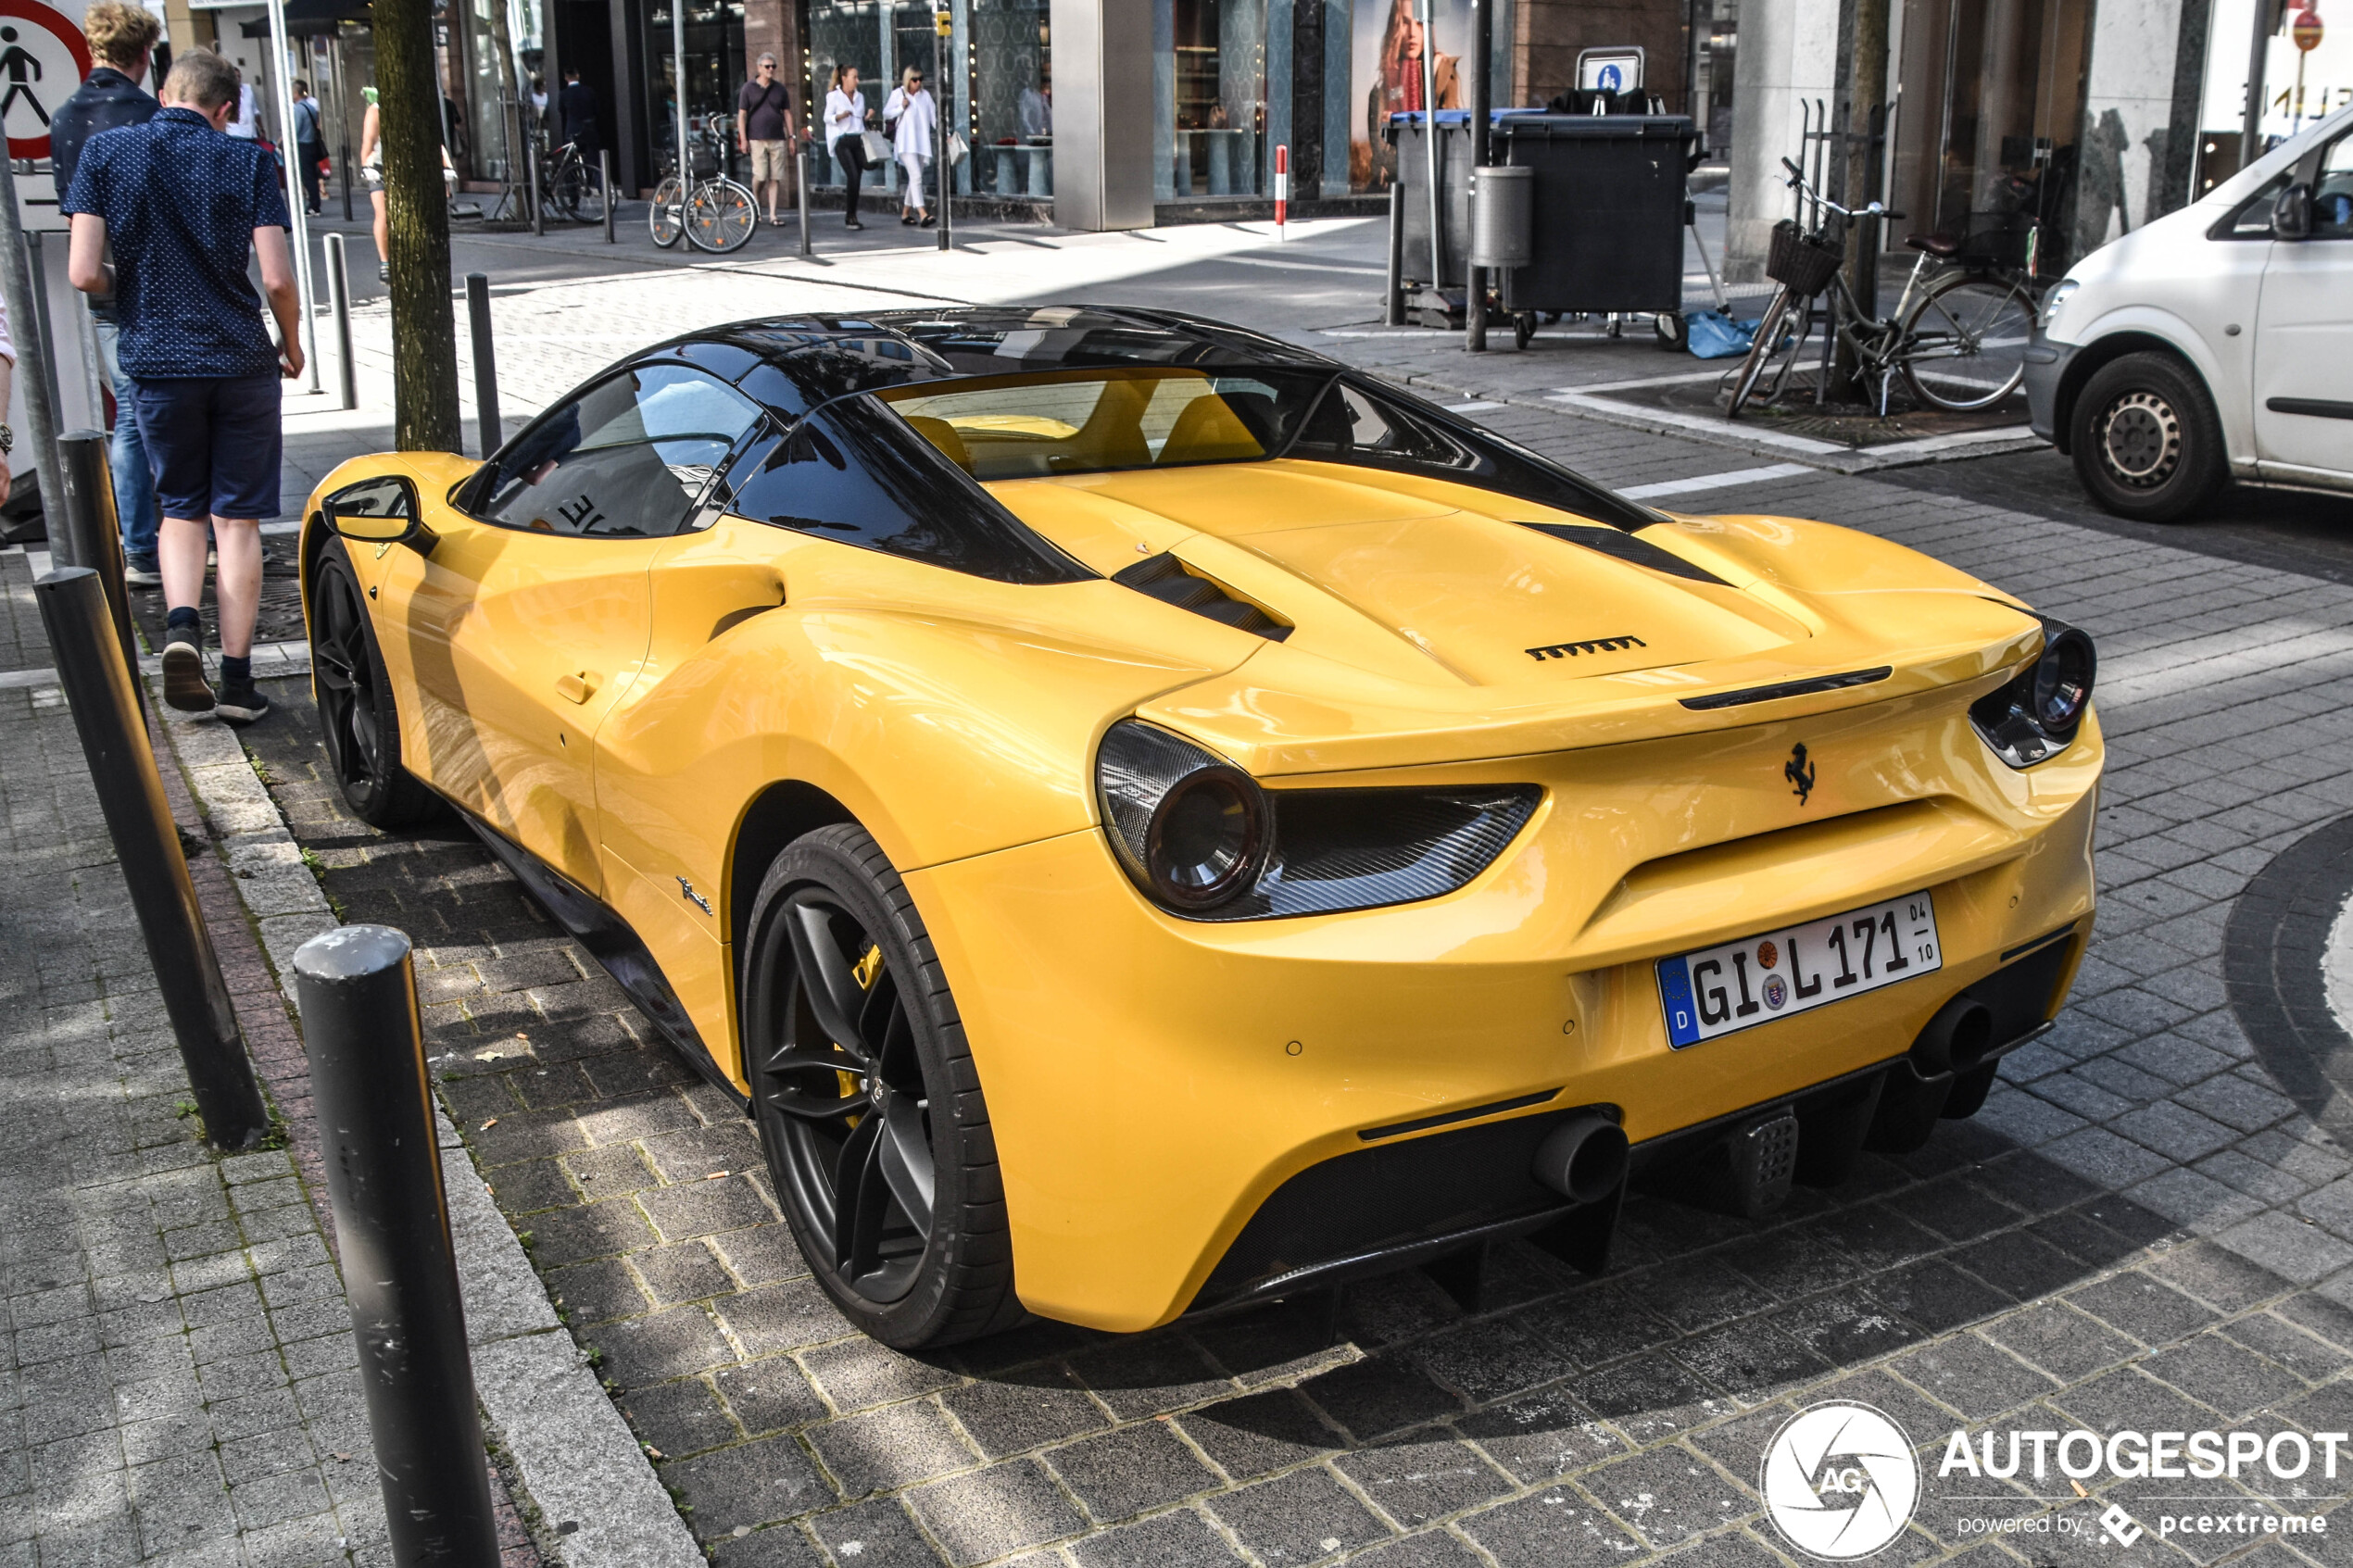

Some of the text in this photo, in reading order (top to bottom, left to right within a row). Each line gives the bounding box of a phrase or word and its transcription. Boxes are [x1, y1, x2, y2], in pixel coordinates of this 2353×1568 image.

[1525, 635, 1646, 661] Ferrari
[1910, 901, 1927, 922] 04
[1917, 943, 1933, 963] 10
[1692, 951, 1759, 1026] GI
[1676, 1010, 1689, 1030] D
